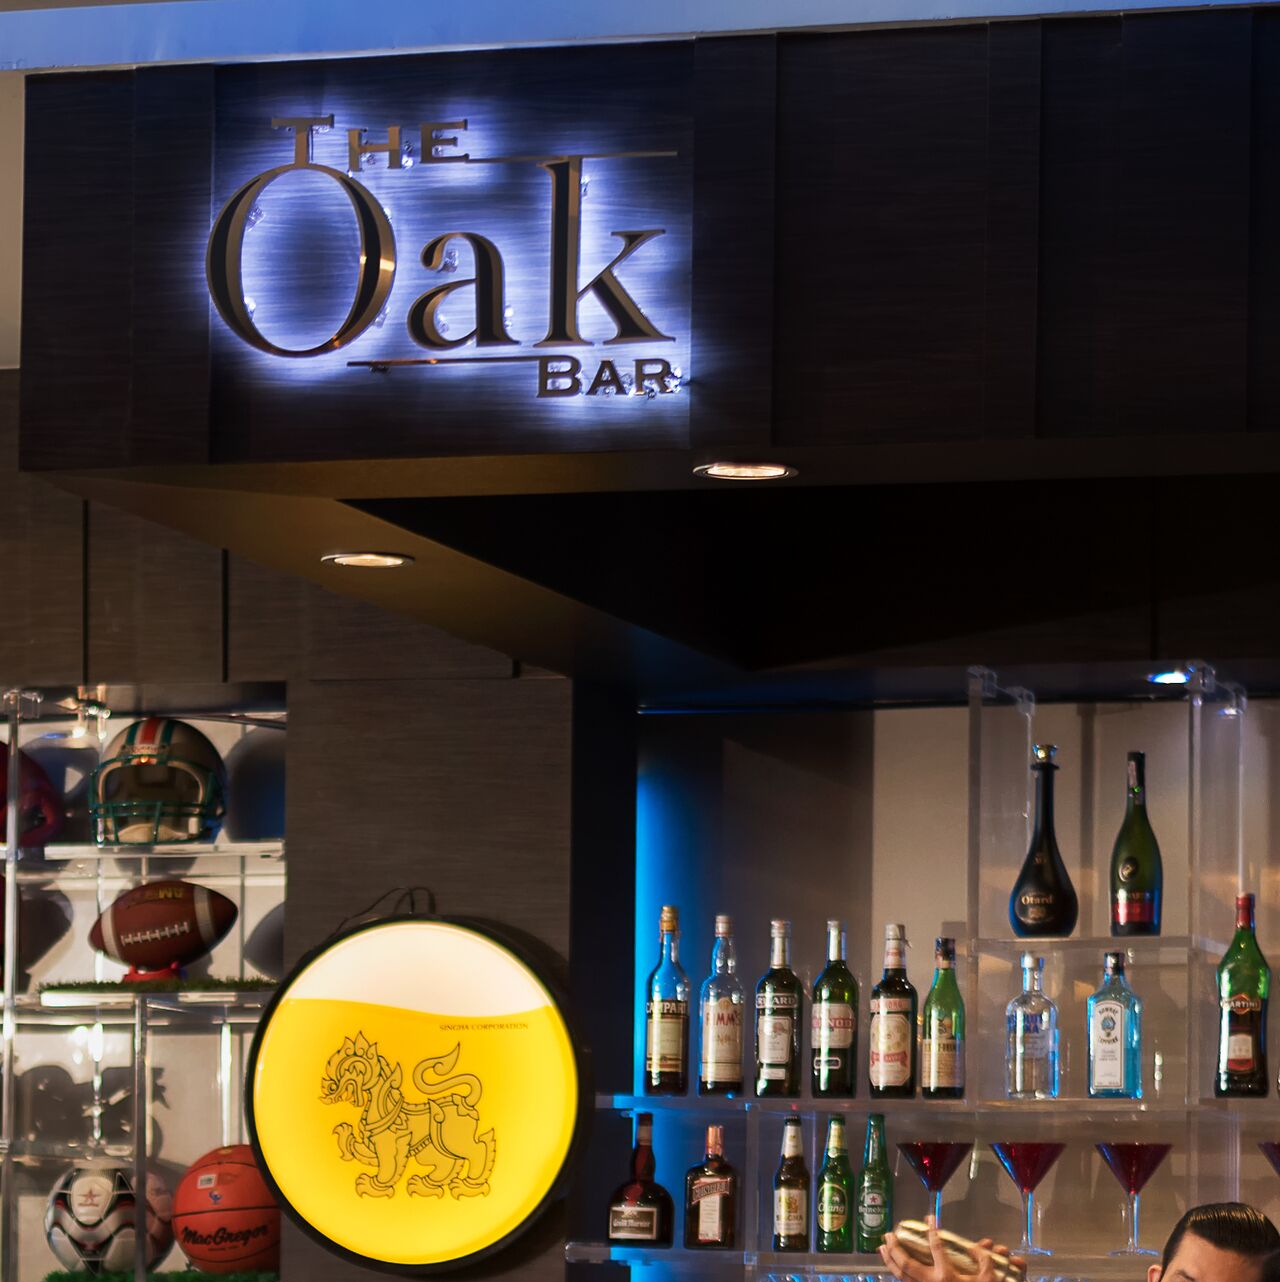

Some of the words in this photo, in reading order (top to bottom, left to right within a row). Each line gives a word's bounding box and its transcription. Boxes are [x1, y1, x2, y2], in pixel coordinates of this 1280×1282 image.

[271, 113, 470, 171] THE
[205, 154, 677, 358] Oak
[536, 354, 675, 398] BAR
[818, 1201, 846, 1213] Cang
[181, 1225, 268, 1246] MacGregor
